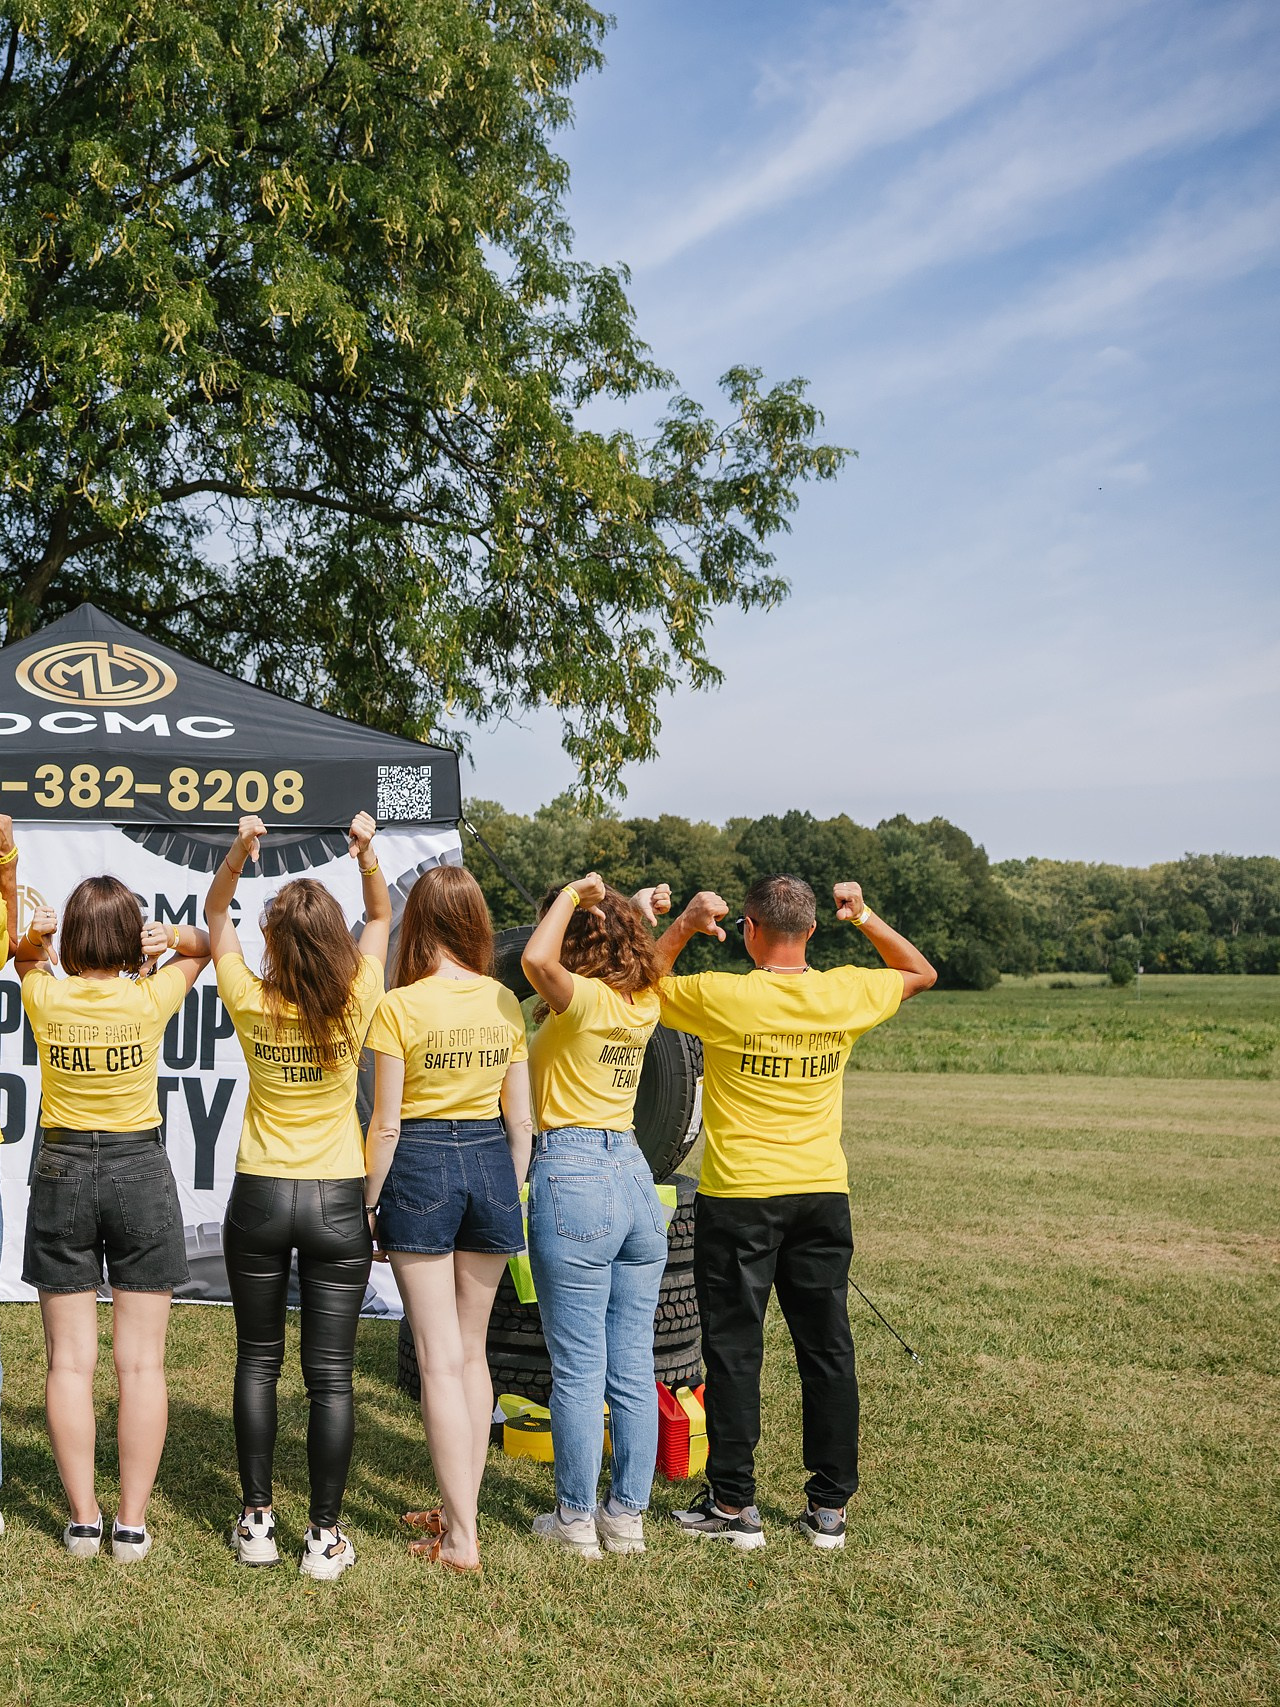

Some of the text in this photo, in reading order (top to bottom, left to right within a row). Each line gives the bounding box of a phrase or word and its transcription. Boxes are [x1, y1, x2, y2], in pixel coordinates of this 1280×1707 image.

[47, 1022, 141, 1044] PIT STOP PARTY
[253, 1024, 269, 1042] PIT
[427, 1024, 509, 1048] PIT STOP PARTY
[606, 1026, 628, 1042] PIT
[743, 1030, 846, 1053] PIT STOP PARTY
[49, 1044, 143, 1072] REAL CEO
[424, 1047, 510, 1069] SAFETY TEAM
[740, 1050, 840, 1078] FLEET TEAM
[281, 1066, 322, 1083] TEAM
